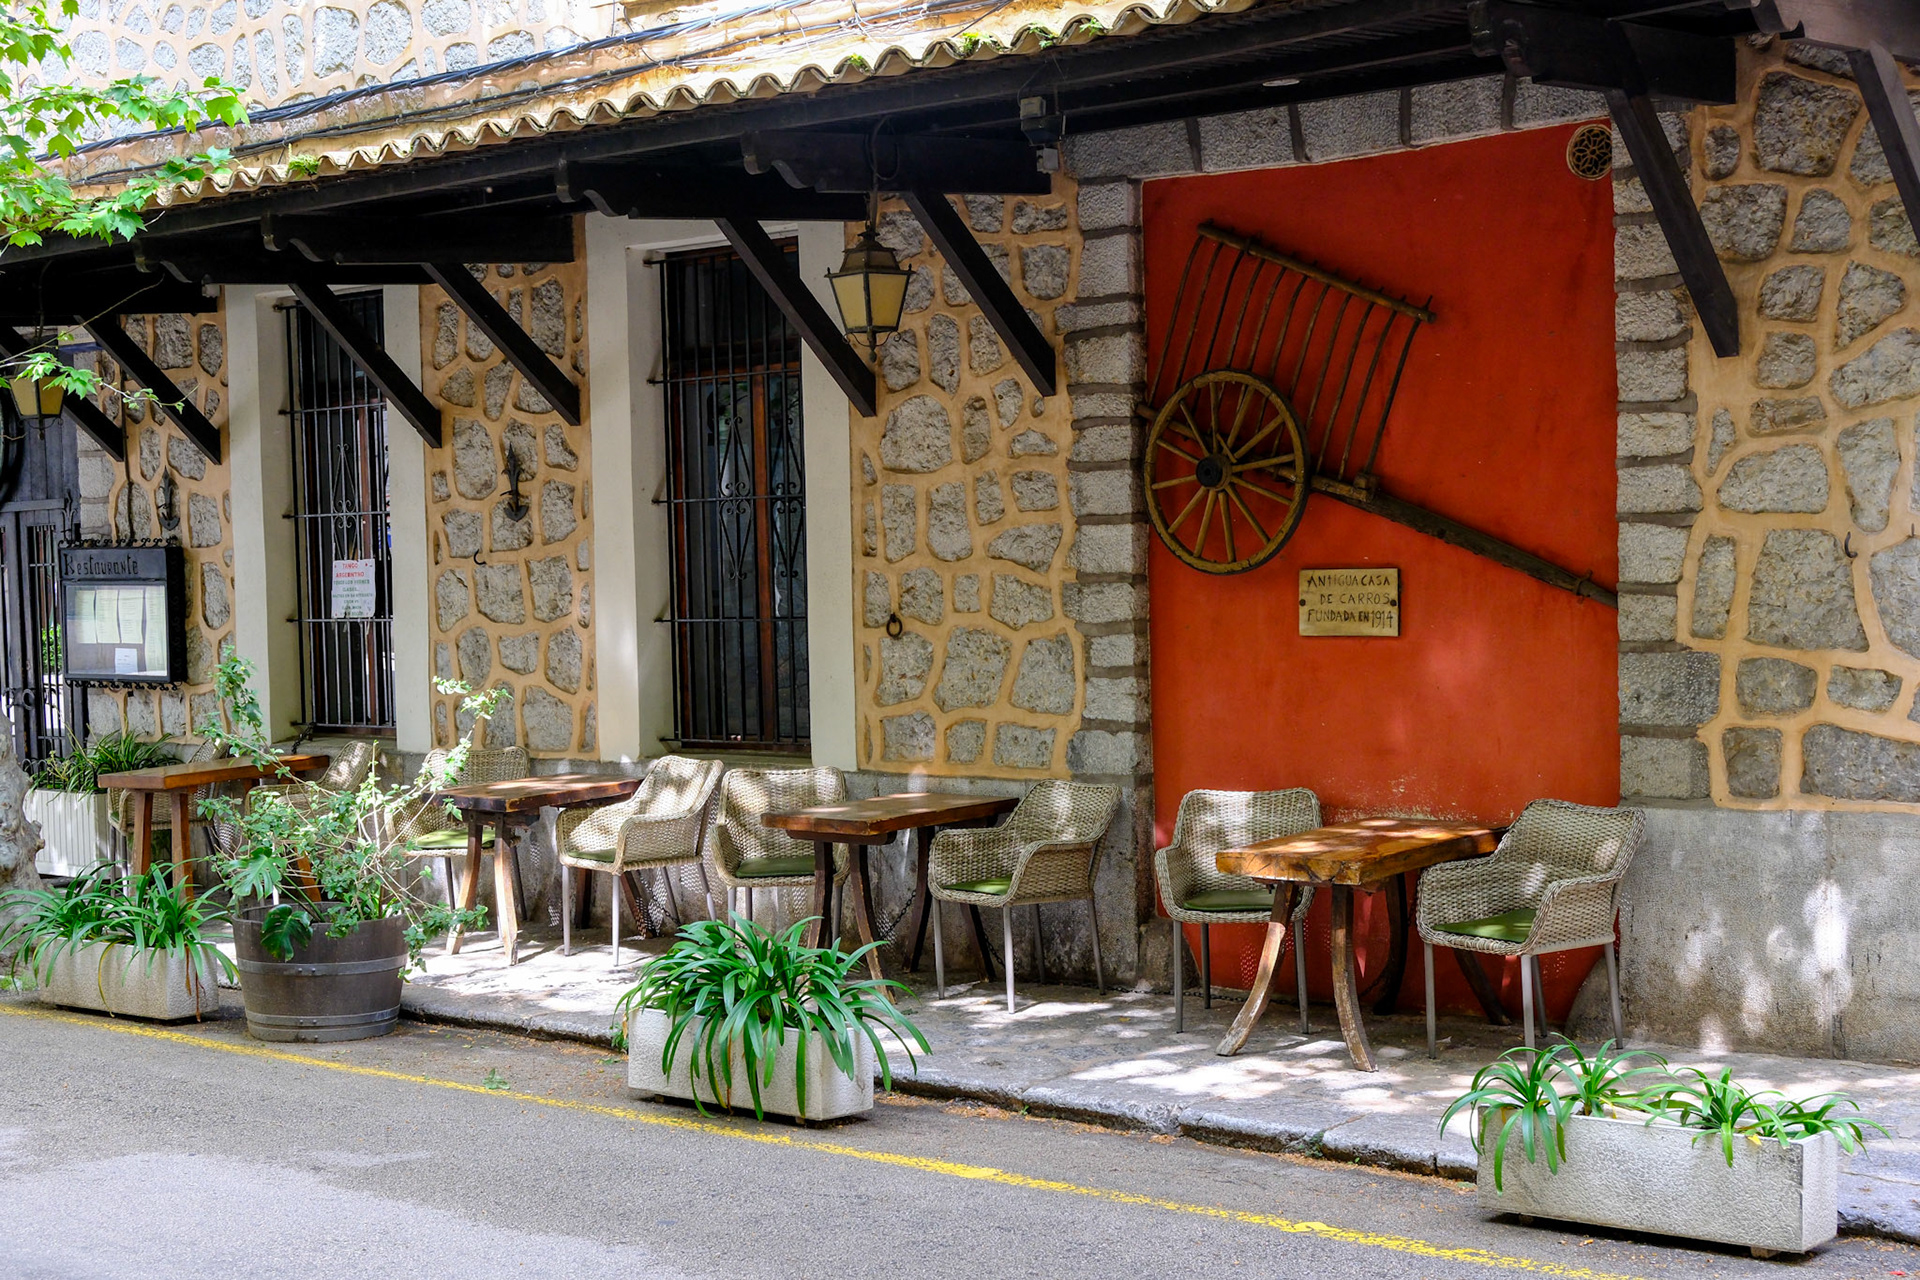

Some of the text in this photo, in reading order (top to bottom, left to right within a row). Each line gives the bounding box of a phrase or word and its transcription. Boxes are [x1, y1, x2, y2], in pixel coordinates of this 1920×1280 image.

[342, 562, 359, 570] TANGO
[1307, 574, 1391, 589] ANTIGUA CASA
[1320, 592, 1390, 605] DE CARROS
[1307, 609, 1393, 628] FUNDADA EN 1914
